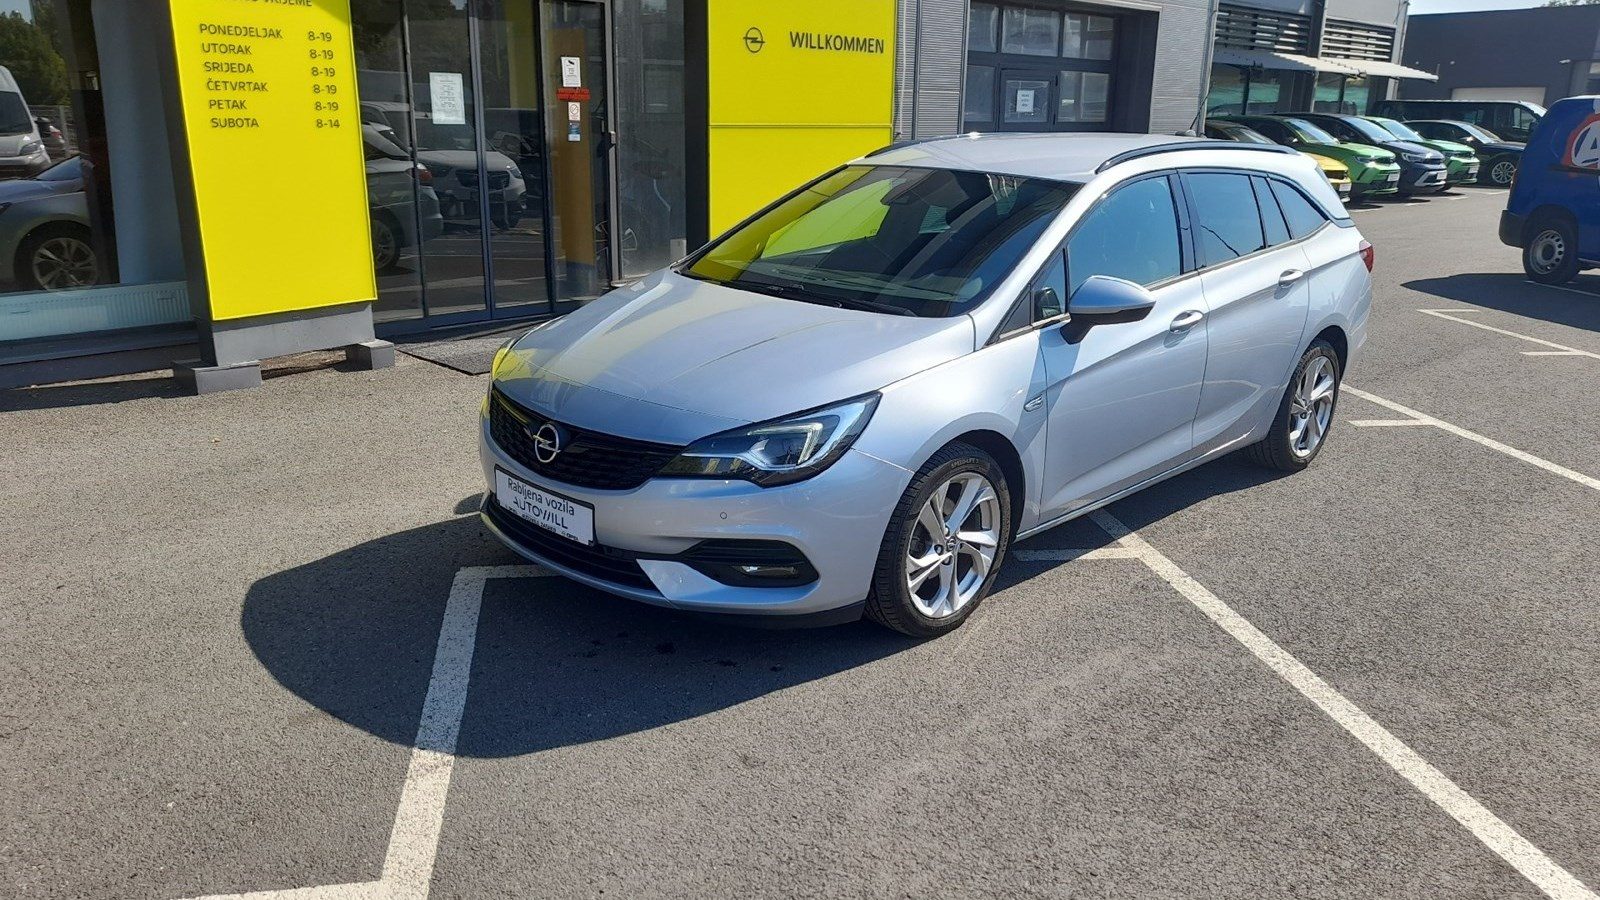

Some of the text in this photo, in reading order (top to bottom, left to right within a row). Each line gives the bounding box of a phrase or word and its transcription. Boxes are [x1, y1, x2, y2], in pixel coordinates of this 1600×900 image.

[200, 23, 333, 42] PONEDJELJAK 8-19
[789, 31, 884, 54] WILLKOMMEN
[201, 43, 334, 60] UTORAK 8-19
[204, 61, 336, 77] SRIJEDA 8-19
[206, 77, 337, 95] ČETVRTAK 8-19
[208, 99, 339, 112] PETAK 8-19
[210, 117, 340, 129] SUBOTA 8-14
[507, 478, 575, 516] Rabljena vozila
